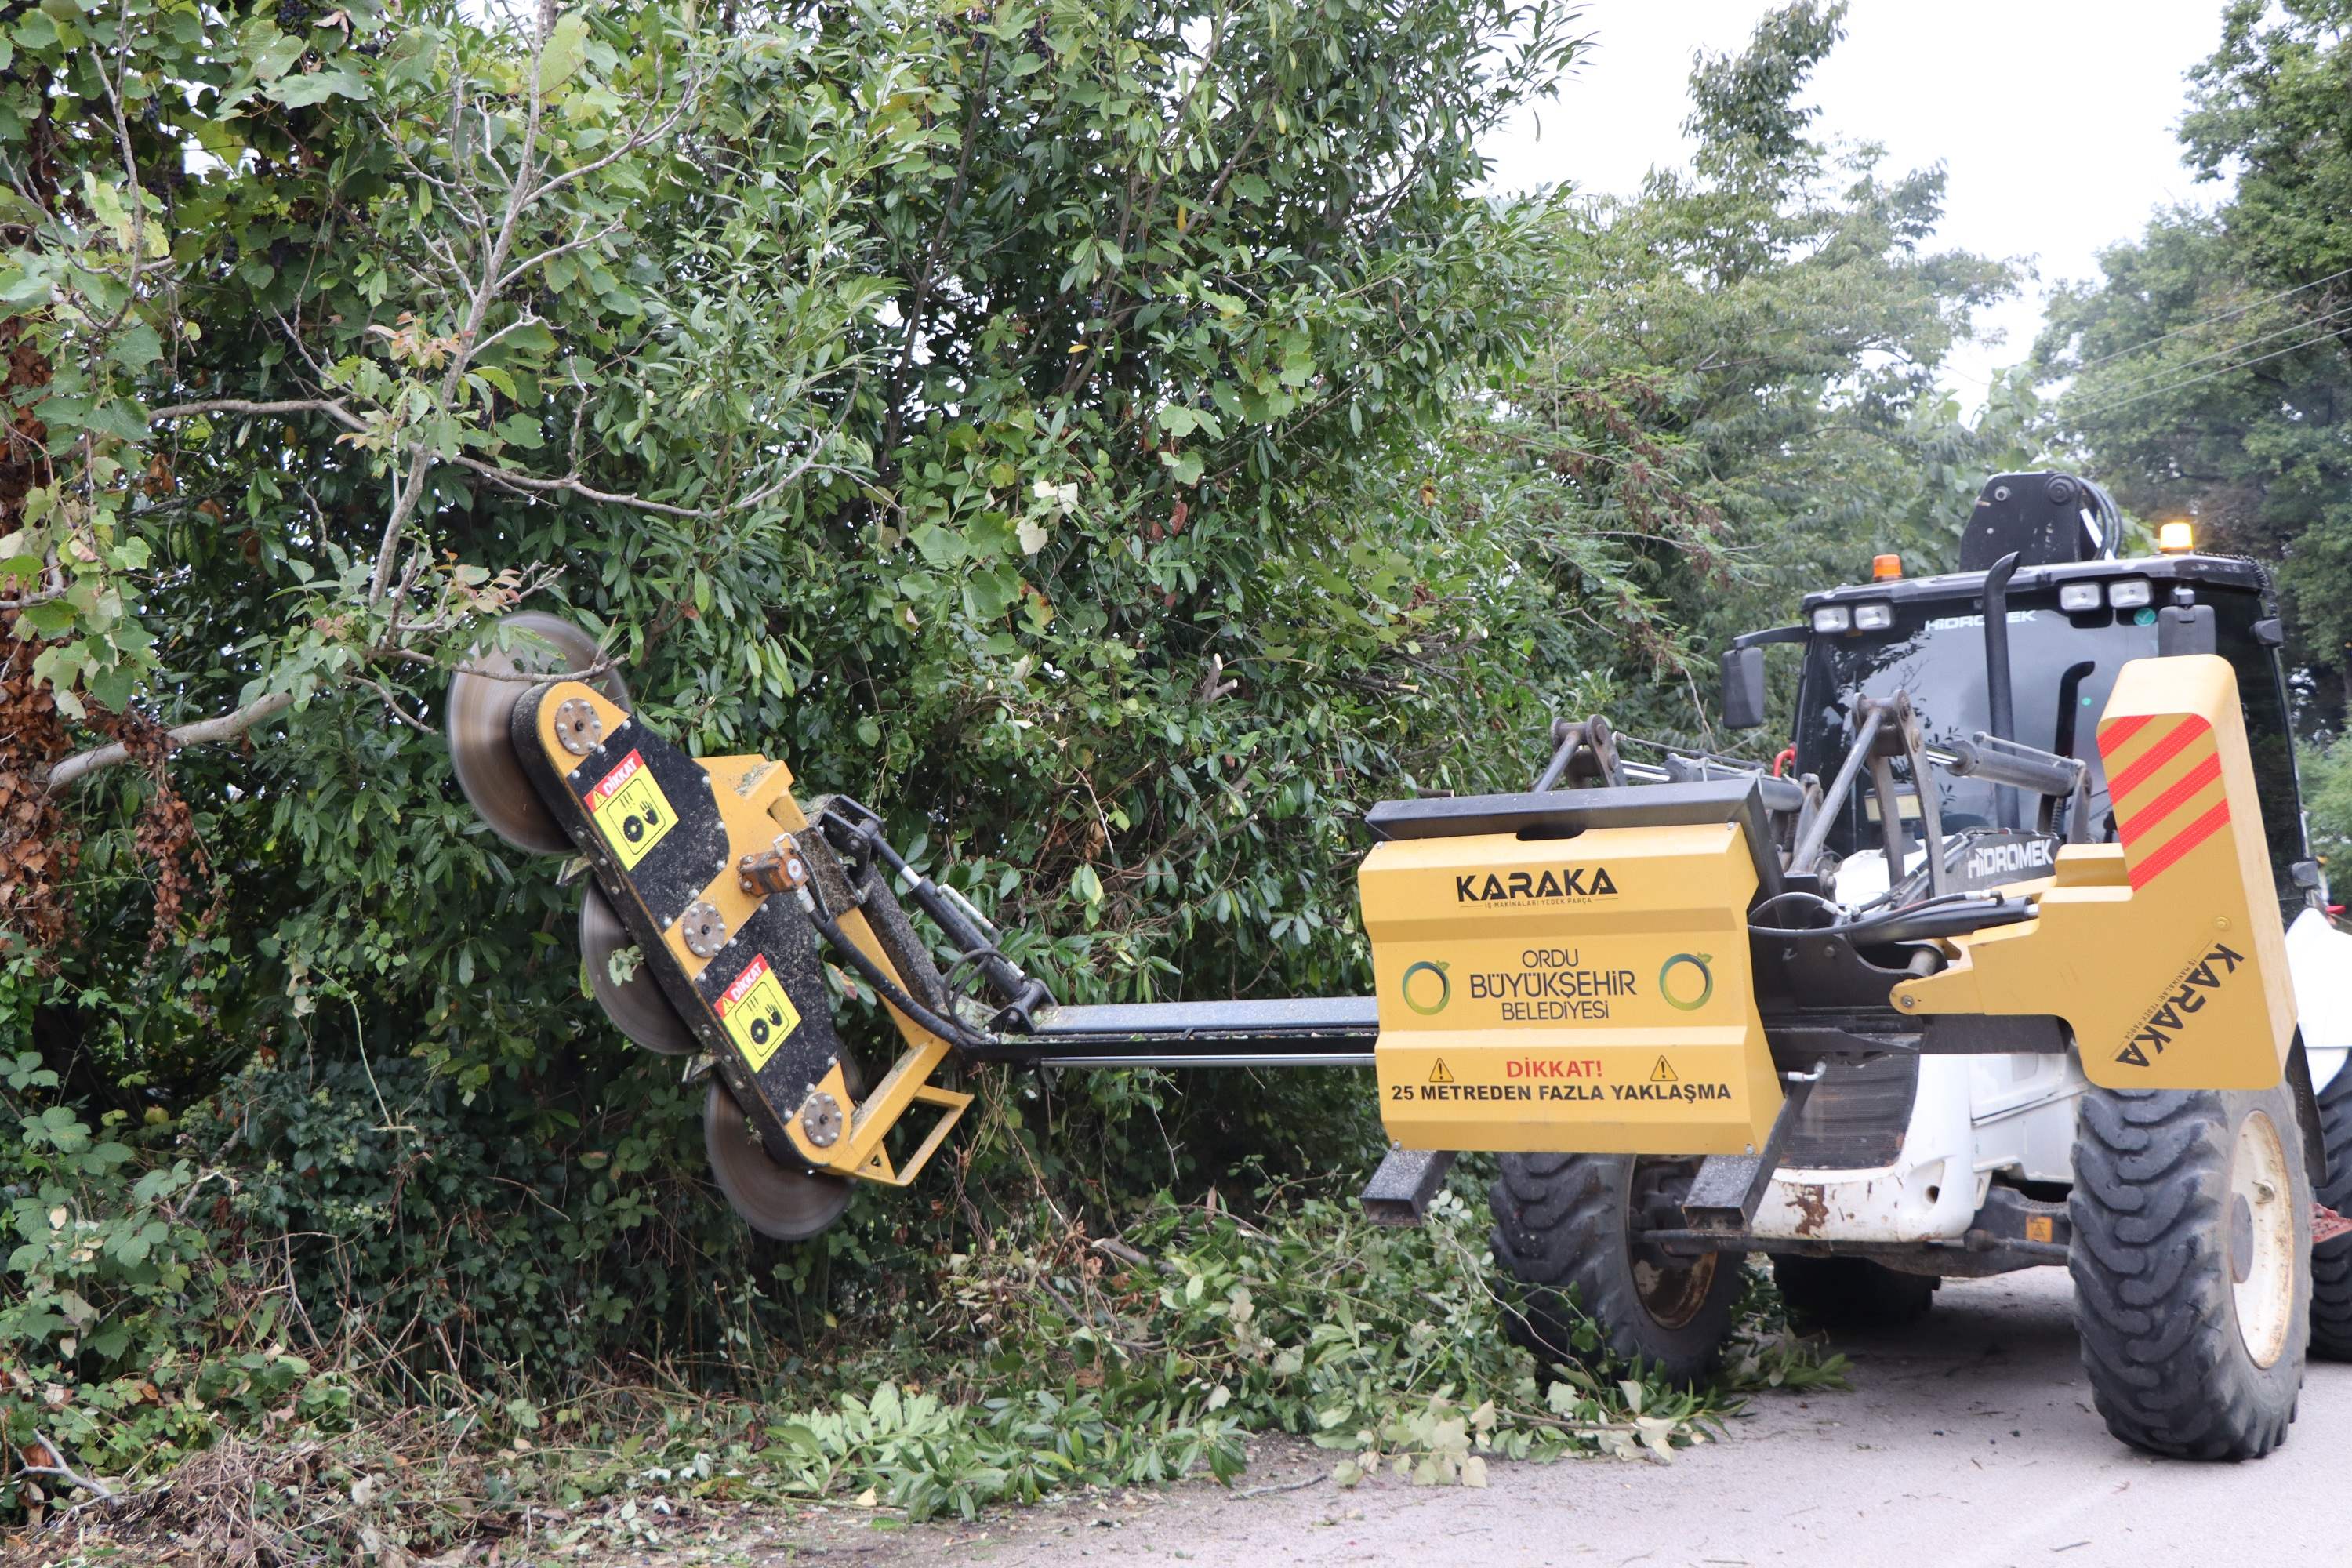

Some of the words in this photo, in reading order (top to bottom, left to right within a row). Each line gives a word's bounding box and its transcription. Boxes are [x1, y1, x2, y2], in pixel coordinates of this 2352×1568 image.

[1455, 867, 1619, 902] KARAKA
[1522, 949, 1579, 968] ORDU
[2114, 942, 2245, 1067] KARAKA
[1506, 1056, 1603, 1079] DİKKAT!
[1391, 1085, 1414, 1101] 25
[1421, 1085, 1532, 1101] METREDEN
[1539, 1085, 1605, 1101] FAZLA
[1610, 1083, 1732, 1104] YAKLAŞMA
